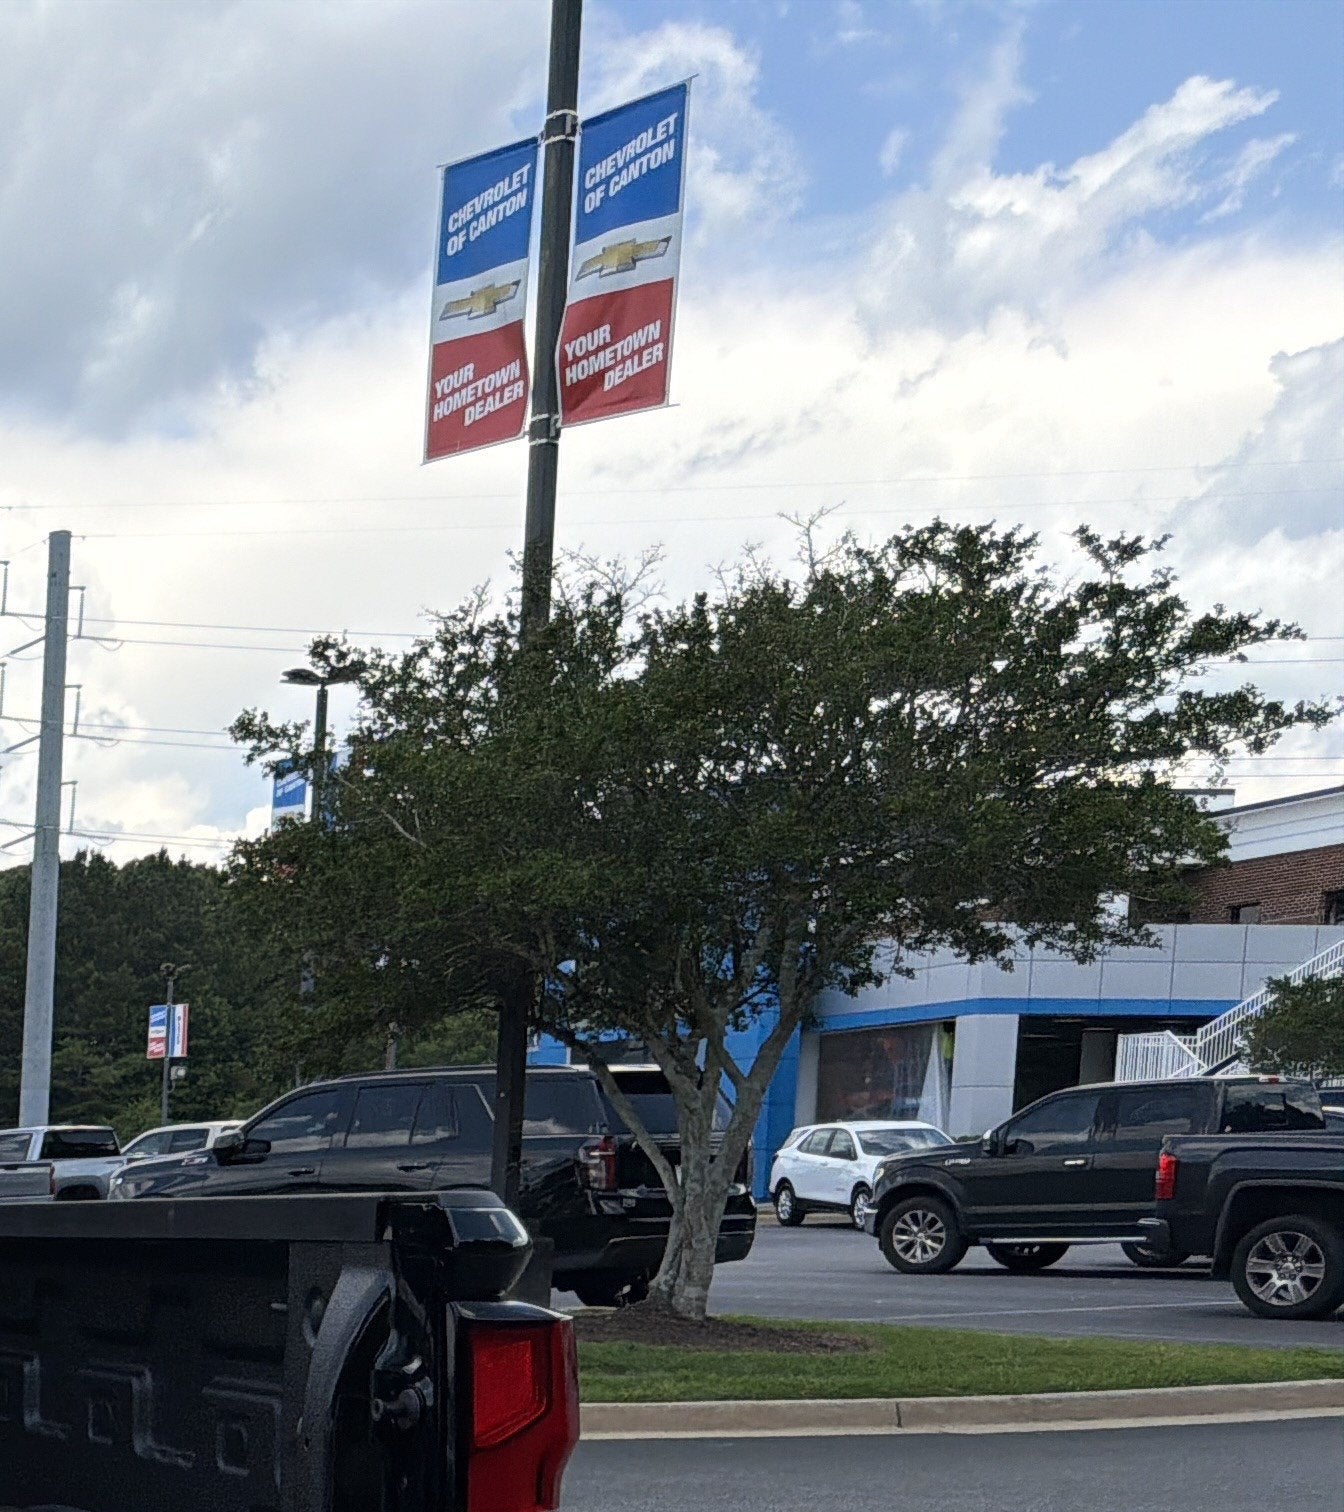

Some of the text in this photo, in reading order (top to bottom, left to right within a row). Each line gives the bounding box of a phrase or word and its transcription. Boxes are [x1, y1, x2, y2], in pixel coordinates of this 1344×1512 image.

[584, 112, 678, 190] CHEVROLET
[584, 138, 675, 214] OF CANTON
[446, 187, 527, 256] OF CANTON
[447, 162, 531, 233] CHEVROLET
[564, 323, 611, 362] YOUR
[565, 319, 661, 387] HOMETOWN
[603, 342, 664, 392] DEALER
[433, 358, 521, 422] HOMETOWN
[435, 362, 475, 399] YOUR
[463, 379, 525, 427] DEALER
